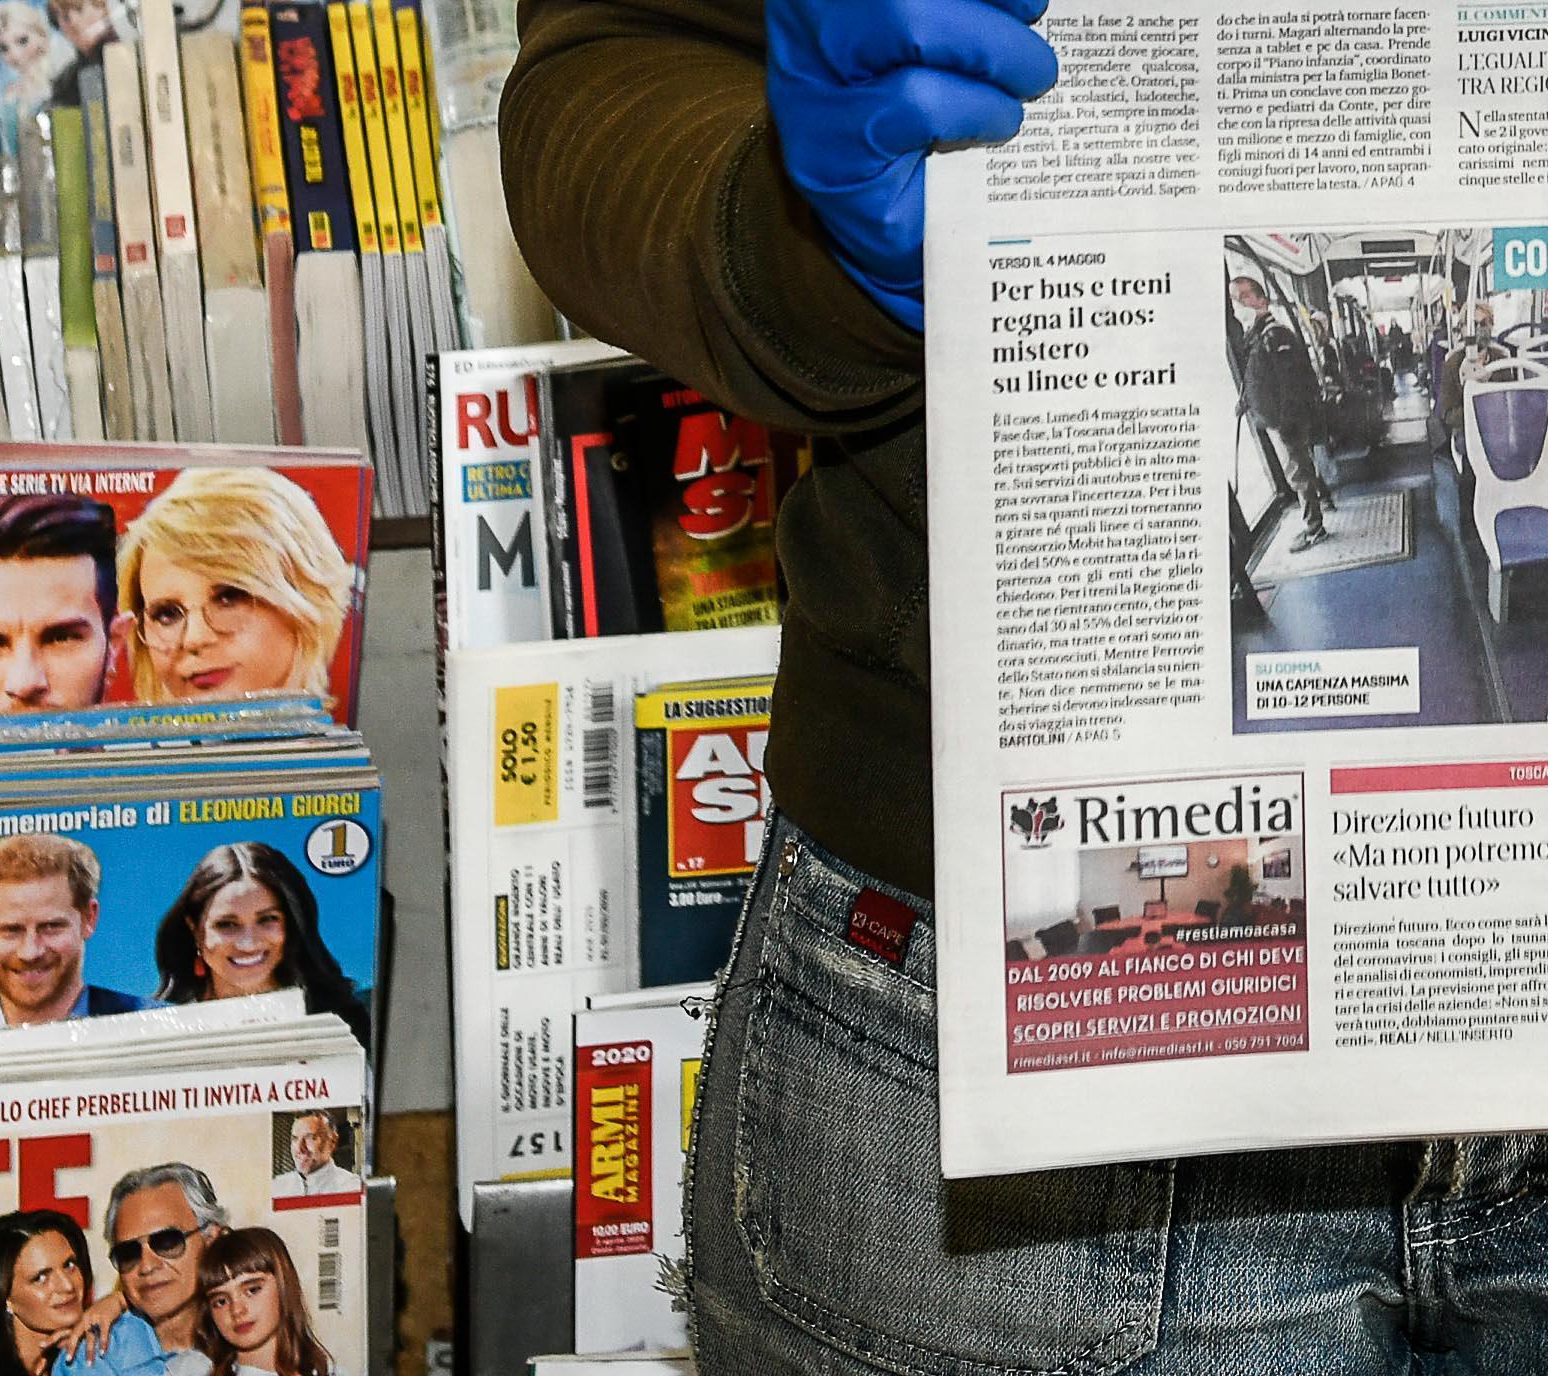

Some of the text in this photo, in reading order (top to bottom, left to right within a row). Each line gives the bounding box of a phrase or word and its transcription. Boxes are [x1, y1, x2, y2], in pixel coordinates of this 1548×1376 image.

[501, 729, 517, 783] SOLO
[1075, 784, 1295, 846] Rimedia
[1175, 922, 1297, 943] #restiamoacasa
[591, 1047, 650, 1066] 2020
[0, 1100, 22, 1123] LO
[28, 1097, 71, 1122] CHEF
[76, 1090, 177, 1118] PERBELLINI
[181, 1089, 198, 1112] TI
[204, 1082, 263, 1109] INVITA
[268, 1082, 280, 1104] A
[285, 1078, 330, 1103] CENA
[590, 1085, 625, 1205] ARMI
[623, 1082, 640, 1205] MAGAZINE
